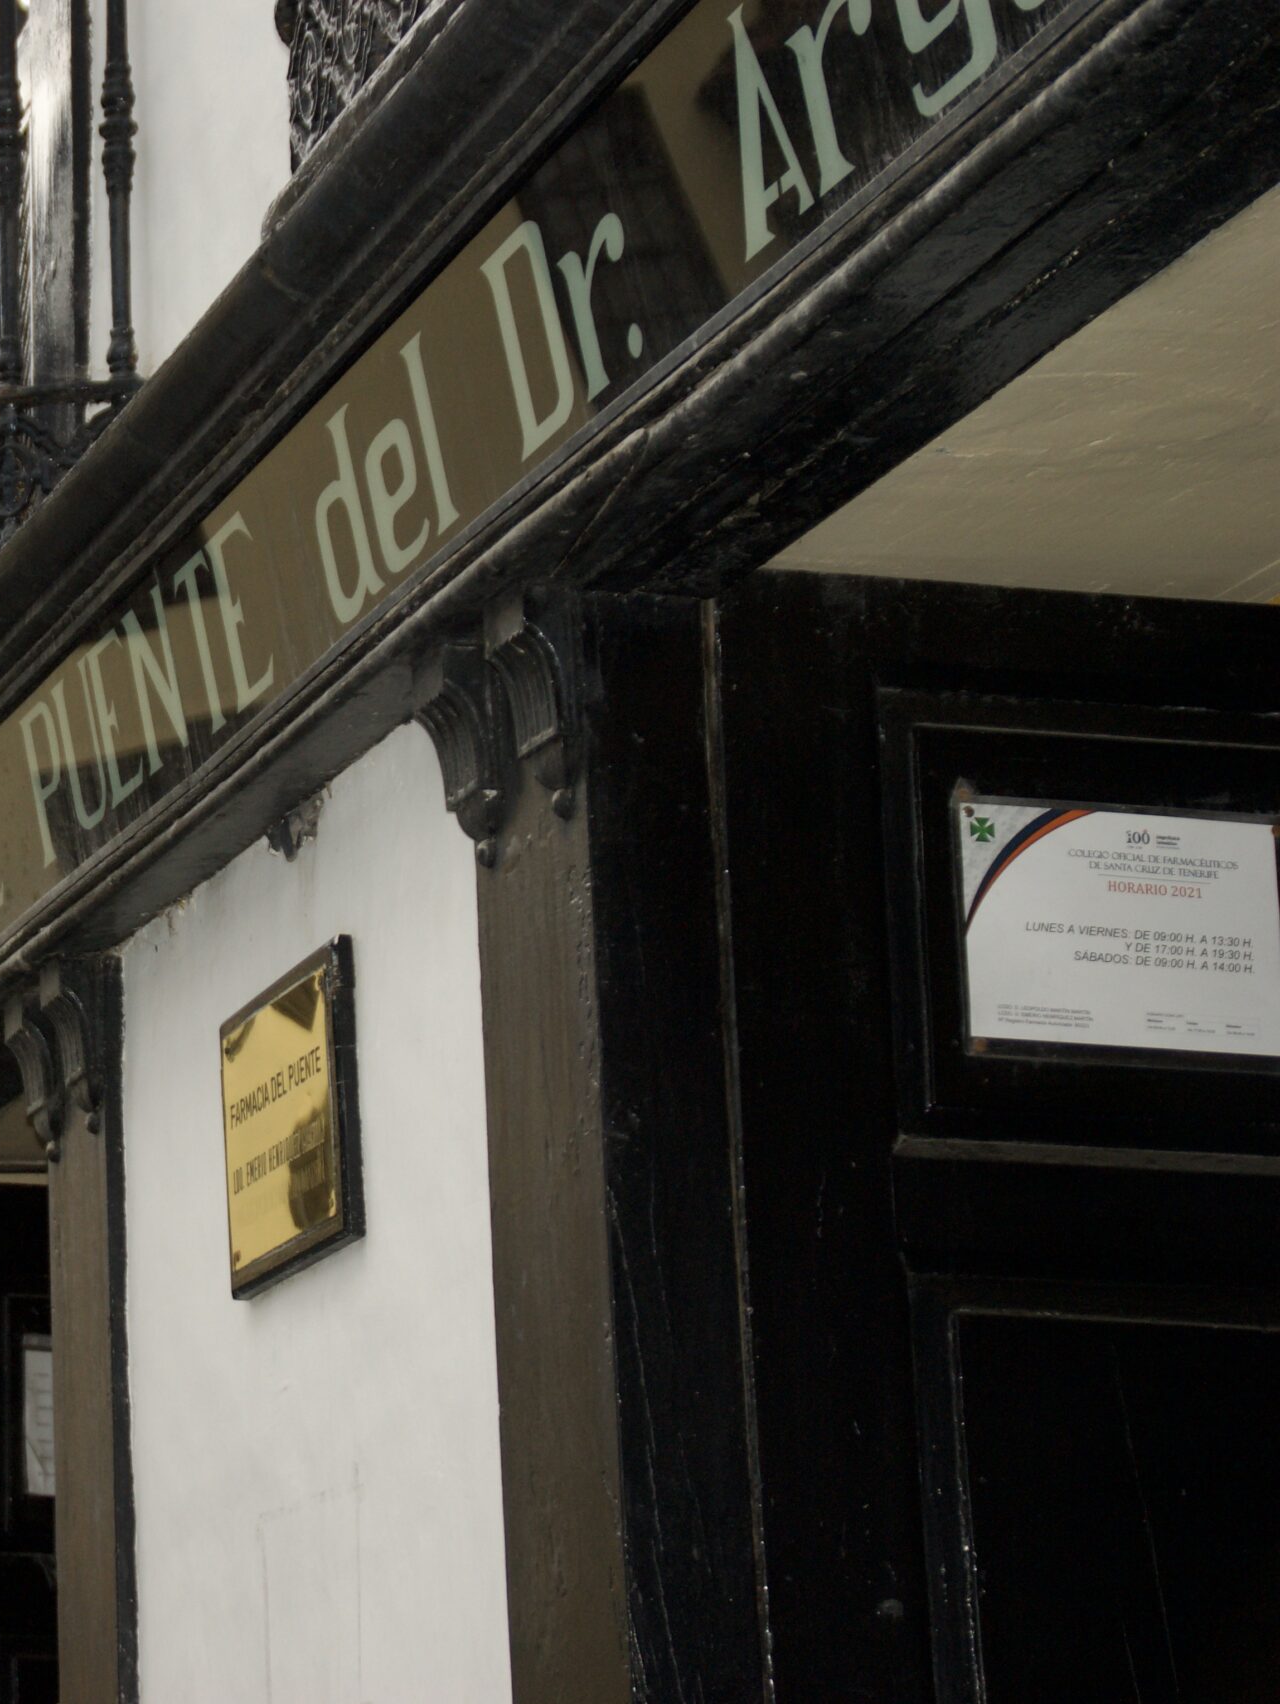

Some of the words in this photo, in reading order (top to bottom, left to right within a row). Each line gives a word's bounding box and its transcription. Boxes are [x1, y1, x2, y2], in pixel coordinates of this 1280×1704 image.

[19, 511, 274, 868] PUENTE
[315, 332, 459, 625] del
[480, 212, 644, 463] Dr.
[727, 0, 1047, 261] Arg
[1068, 848, 1110, 860] COLEGIO
[1112, 851, 1144, 863] OFICIAL
[1148, 854, 1161, 864] DE
[1089, 860, 1101, 870] DE
[1104, 862, 1132, 873] SANTA
[1134, 864, 1161, 875] CRUZ
[1163, 866, 1176, 876] DE
[1178, 868, 1220, 880] TENERIFE
[1108, 880, 1168, 896] HORARIO
[1170, 885, 1203, 899] 2021
[1025, 921, 1065, 934] LUNES
[1067, 924, 1076, 934] A
[1134, 929, 1151, 940] DE
[1153, 931, 1183, 943] 09:00
[1185, 934, 1197, 944] H.
[1200, 935, 1209, 945] A
[1211, 936, 1240, 948] 13:30
[1242, 938, 1255, 949] H.
[1125, 942, 1133, 952] Y
[1135, 942, 1151, 953] DE
[1155, 944, 1184, 956] 17:00
[1186, 947, 1197, 957] H.
[1200, 948, 1209, 958] A
[1212, 949, 1241, 960] 19:30
[1243, 951, 1255, 961] H.
[1135, 955, 1151, 967] DE
[1154, 957, 1184, 969] 09:00
[1186, 960, 1197, 970] H.
[1201, 961, 1210, 971] A
[1213, 962, 1241, 974] 14:00
[1243, 964, 1256, 975] H.
[230, 1082, 271, 1130] FARMACIA
[270, 1071, 287, 1103] DEL
[288, 1046, 322, 1091] PUENTE
